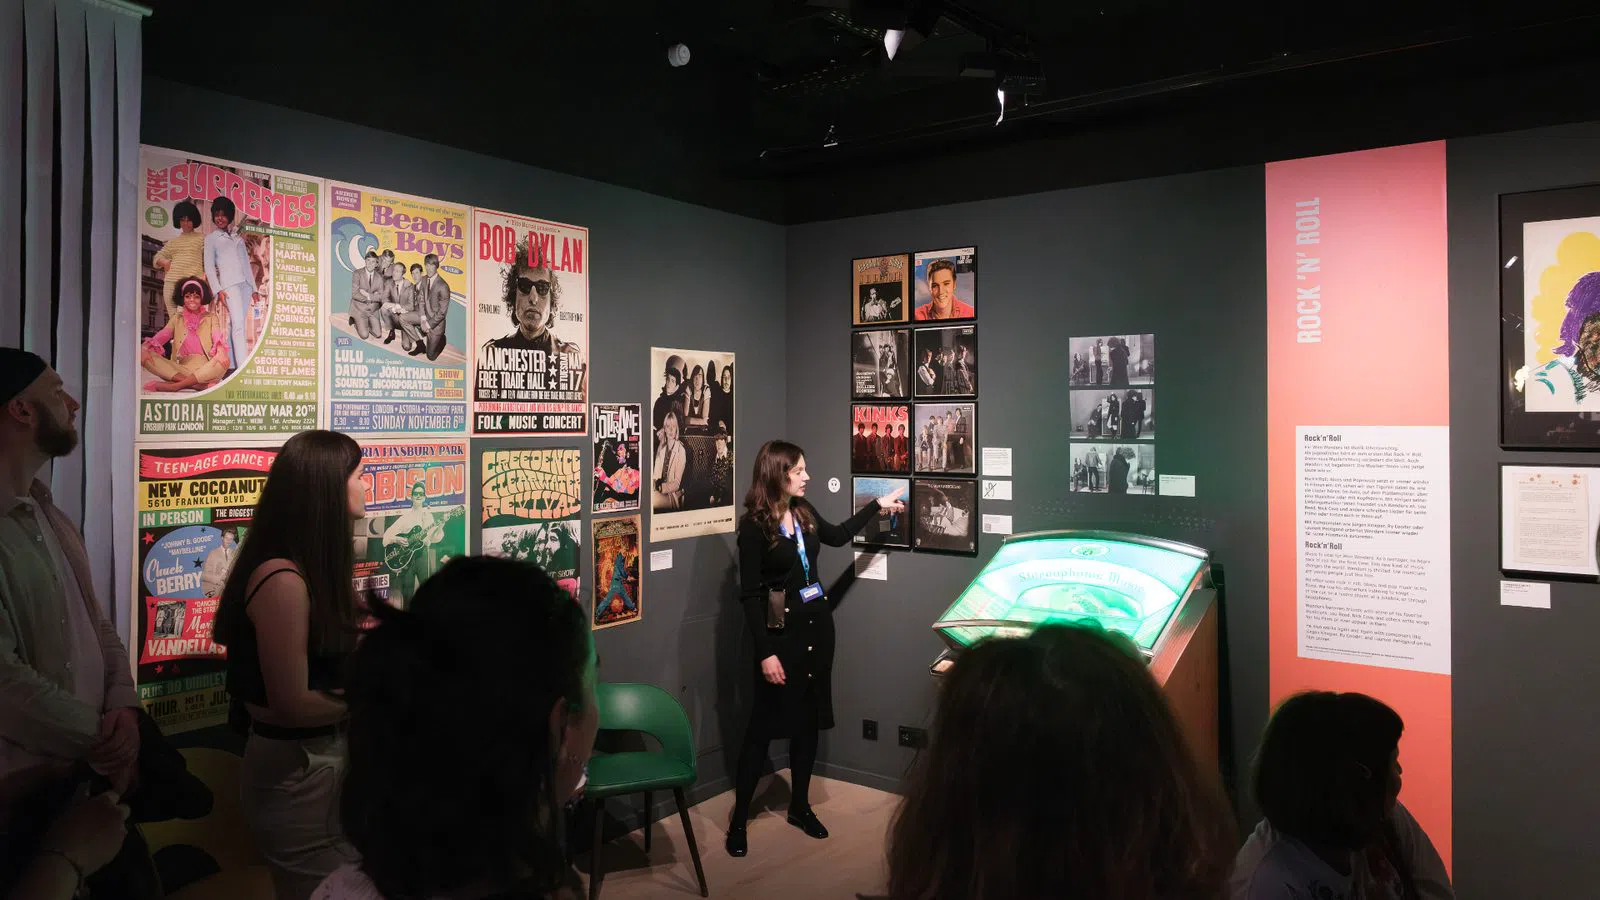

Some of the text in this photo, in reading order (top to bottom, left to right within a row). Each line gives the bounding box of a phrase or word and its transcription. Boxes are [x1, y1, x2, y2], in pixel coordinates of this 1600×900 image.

[146, 167, 168, 202] THE
[170, 163, 316, 228] SUPREMES
[370, 204, 464, 240] Beach
[1296, 197, 1320, 244] ROLL
[395, 231, 464, 263] Boys
[480, 222, 582, 273] BOB DYLAN
[275, 249, 316, 262] MARTHA
[275, 263, 316, 274] VANDELLAS
[275, 281, 308, 293] STEVIE
[276, 292, 315, 303] WONDER
[275, 304, 316, 316] SMOKEY
[1296, 285, 1321, 343] ROCK
[274, 314, 316, 324] ROBINSON
[271, 327, 316, 337] MIRACLES
[254, 356, 315, 366] GEORGIE FAME
[335, 349, 363, 363] LULU
[479, 347, 546, 372] MANCHESTER
[568, 352, 583, 369] MAY
[256, 366, 315, 376] BLUE FLAMES
[335, 364, 368, 377] DAVID
[379, 366, 433, 380] JONATHAN
[438, 370, 460, 378] SHOW
[560, 352, 568, 382] TUESDAY
[335, 378, 433, 390] SOUNDS INCORPORATED
[479, 370, 498, 388] FREE
[501, 371, 525, 389] TRADE
[527, 373, 546, 390] HALL
[569, 370, 583, 390] 17
[144, 403, 204, 421] ASTORIA
[212, 404, 315, 417] SATURDAY MAR 20TH
[372, 404, 394, 414] LONDON
[399, 405, 420, 414] ASTORIA
[425, 405, 449, 414] FINSBURY
[452, 406, 464, 414] PARK
[854, 406, 908, 422] KINKS
[177, 422, 204, 431] LONDON
[372, 415, 405, 429] SUNDAY
[408, 415, 450, 429] NOVEMBER
[478, 415, 582, 430] FOLK MUSIC CONCERT
[594, 406, 640, 443] COLTRANE
[383, 446, 437, 457] FINSBURY
[439, 445, 464, 455] PARK
[154, 455, 219, 474] TEEN-AGE
[223, 454, 264, 466] DANCE
[148, 482, 182, 498] NEW
[362, 464, 464, 506] RBISON
[176, 497, 219, 506] FRANKLIN
[143, 510, 203, 526] IN PERSON
[216, 508, 254, 517] THE BIGGEST
[1305, 541, 1342, 550] Rock'n'Roll
[146, 558, 184, 582] Chuck
[558, 568, 575, 577] SHOW
[156, 572, 202, 595] BERRY
[148, 640, 226, 657] VANDELLAS
[142, 684, 163, 698] PLUS
